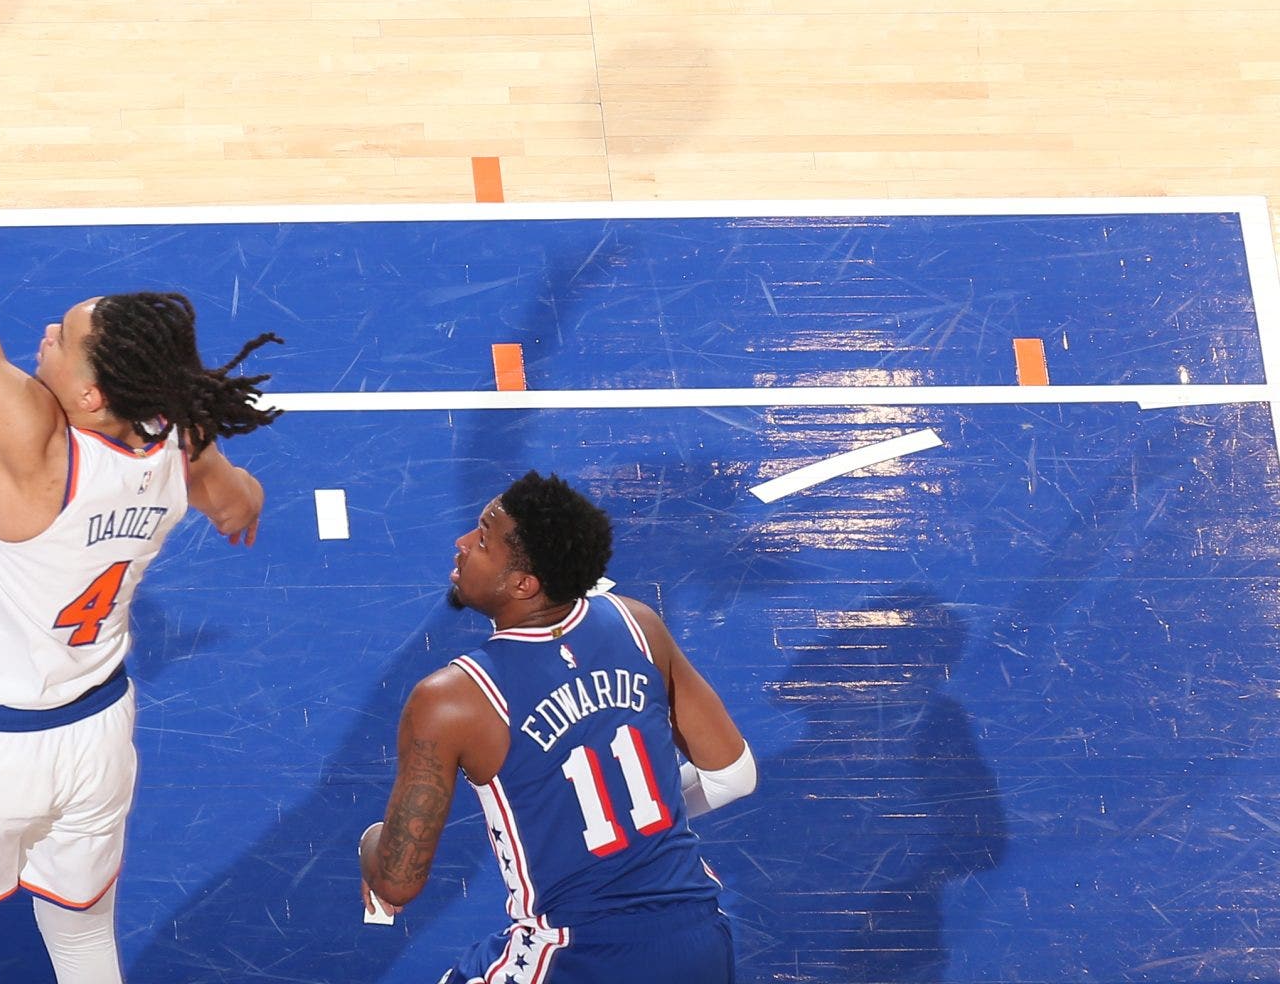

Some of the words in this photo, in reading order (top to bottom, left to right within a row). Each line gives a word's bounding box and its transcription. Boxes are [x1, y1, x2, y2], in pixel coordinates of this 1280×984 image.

[86, 505, 169, 548] DADIET
[51, 558, 134, 648] 4
[520, 667, 650, 753] EDWARDS
[561, 724, 673, 858] 11
